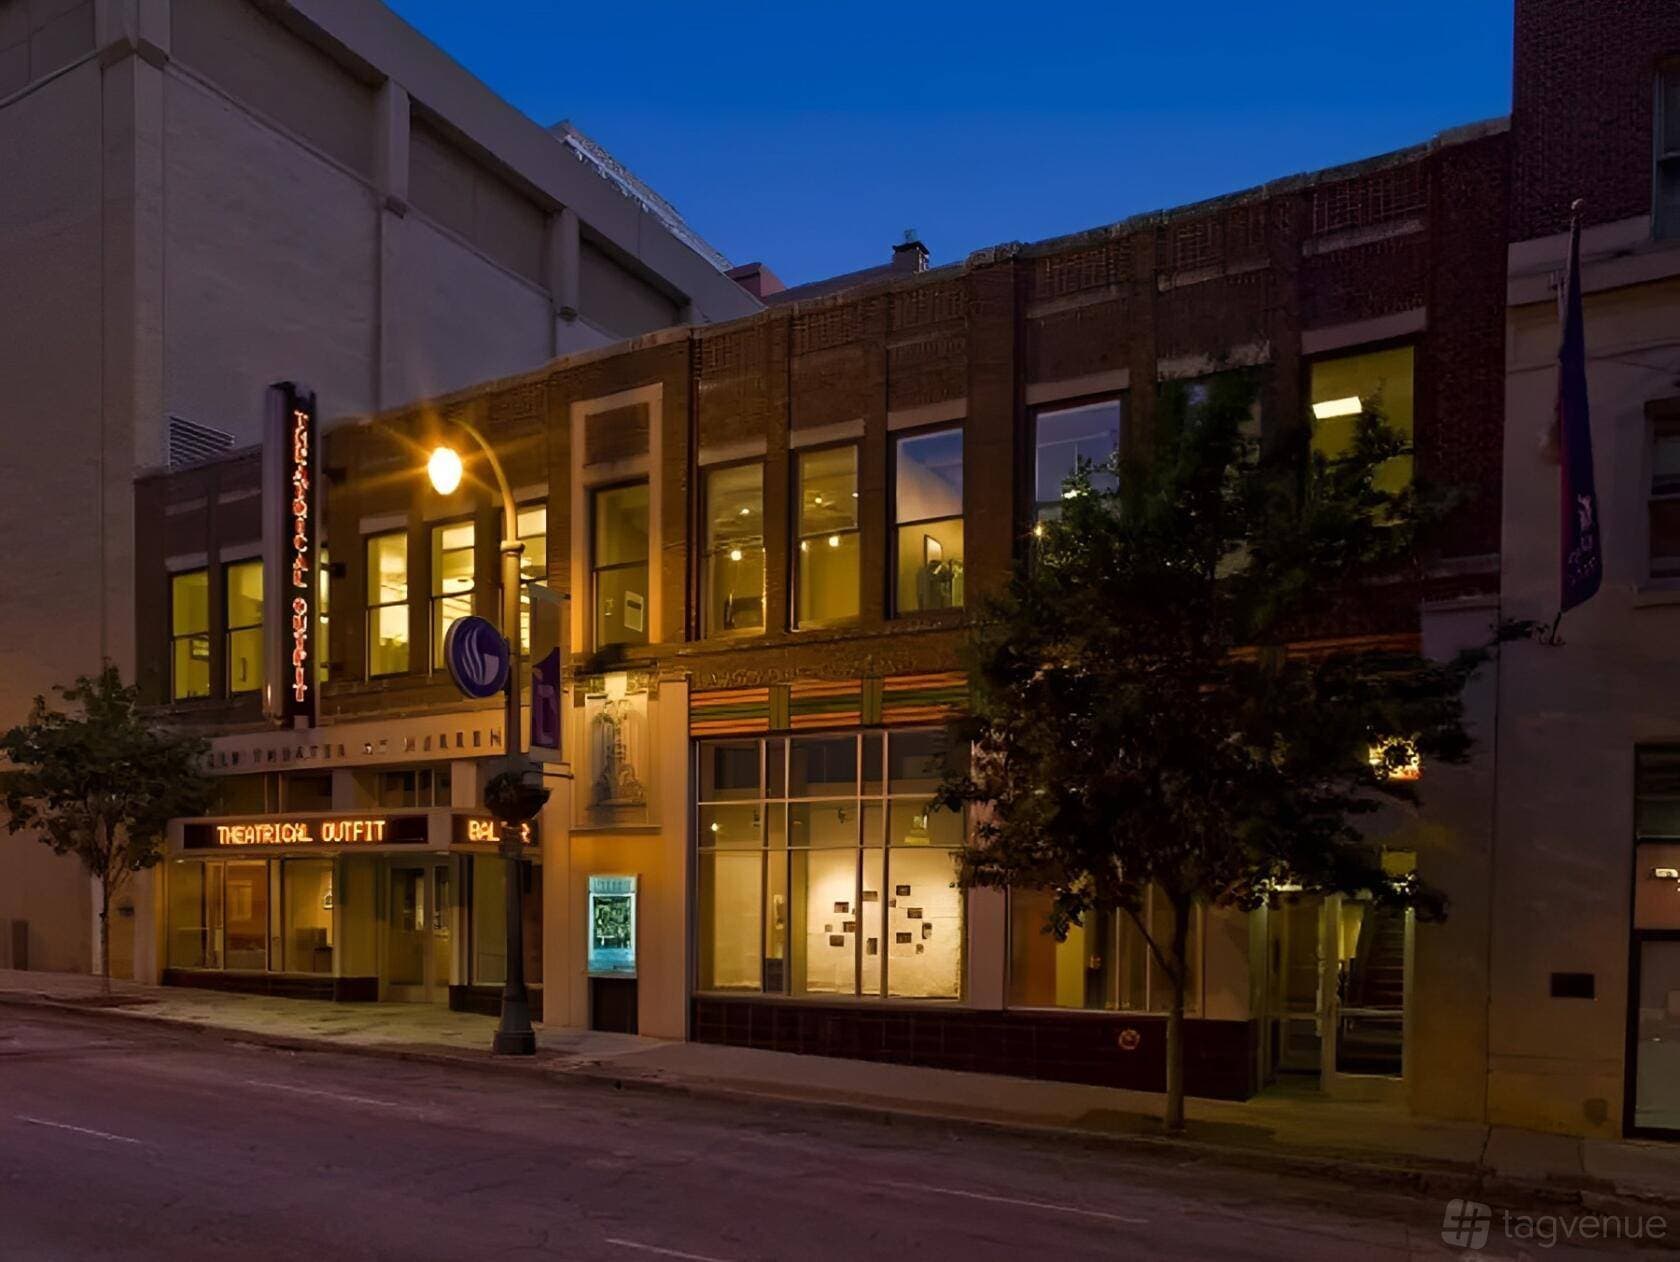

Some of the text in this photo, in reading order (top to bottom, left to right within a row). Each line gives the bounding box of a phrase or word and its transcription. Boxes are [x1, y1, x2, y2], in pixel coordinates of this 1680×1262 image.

[292, 597, 308, 702] OUTFIT
[216, 819, 386, 845] THEATRICAL OUTFIT
